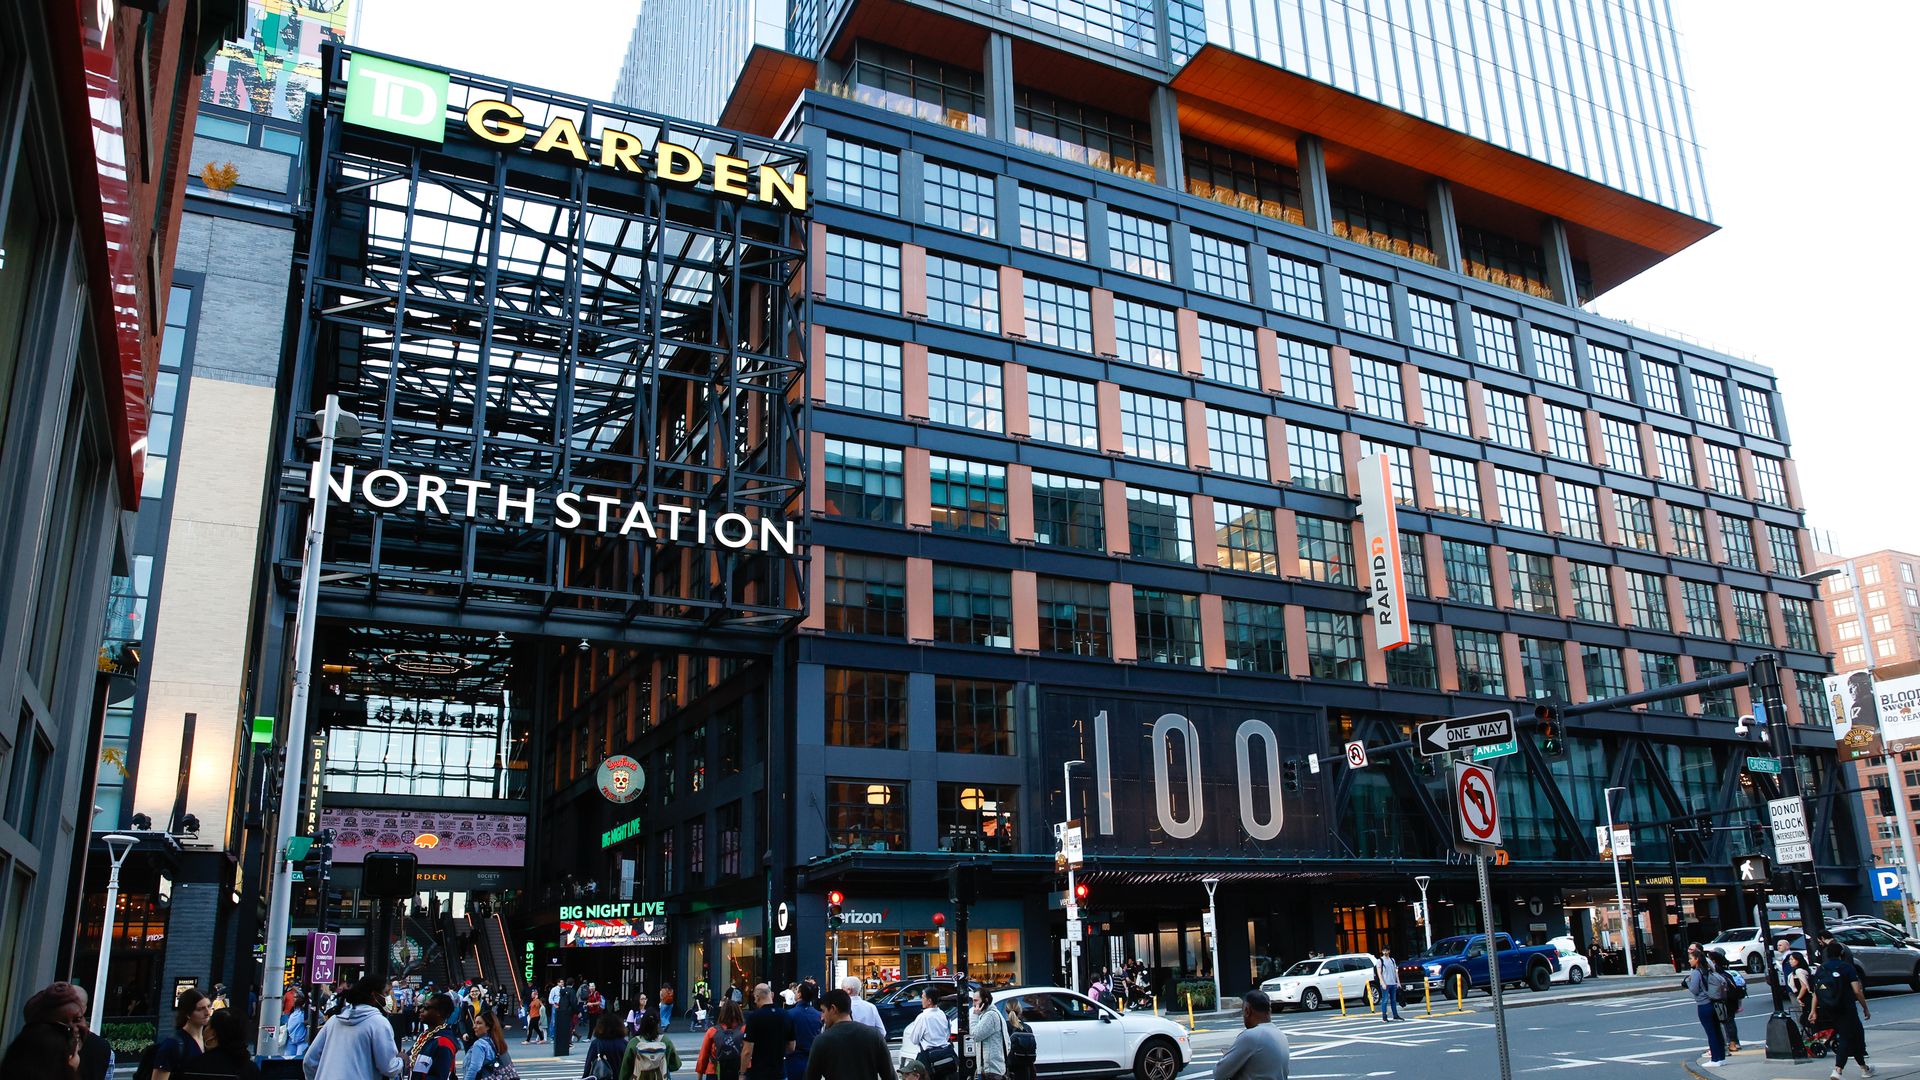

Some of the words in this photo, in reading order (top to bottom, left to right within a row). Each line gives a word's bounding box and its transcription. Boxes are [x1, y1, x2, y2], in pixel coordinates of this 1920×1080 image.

[359, 69, 437, 127] TD
[466, 98, 808, 211] GARDEN
[310, 461, 535, 525] NORTH
[555, 491, 795, 554] STATION
[375, 705, 496, 729] GARDEN
[1447, 727, 1471, 742] ONE
[1477, 722, 1503, 737] WAY
[1474, 744, 1503, 756] ANAL
[1094, 710, 1284, 841] 100
[307, 748, 322, 835] BANNERS
[1772, 805, 1783, 817] DO
[1784, 803, 1800, 815] NOT
[602, 831, 610, 849] BIG
[611, 823, 627, 845] NIGHT
[628, 817, 640, 838] LIVE
[1774, 817, 1804, 831] BLOCK
[1776, 831, 1806, 840] INTERSECTION
[416, 873, 447, 881] RDEN
[1877, 871, 1899, 897] P
[560, 905, 583, 920] BIG
[586, 903, 631, 918] NIGHT
[633, 901, 665, 916] LIVE
[836, 909, 882, 924] erizon
[580, 926, 603, 938] NOW
[605, 925, 633, 937] OPEN
